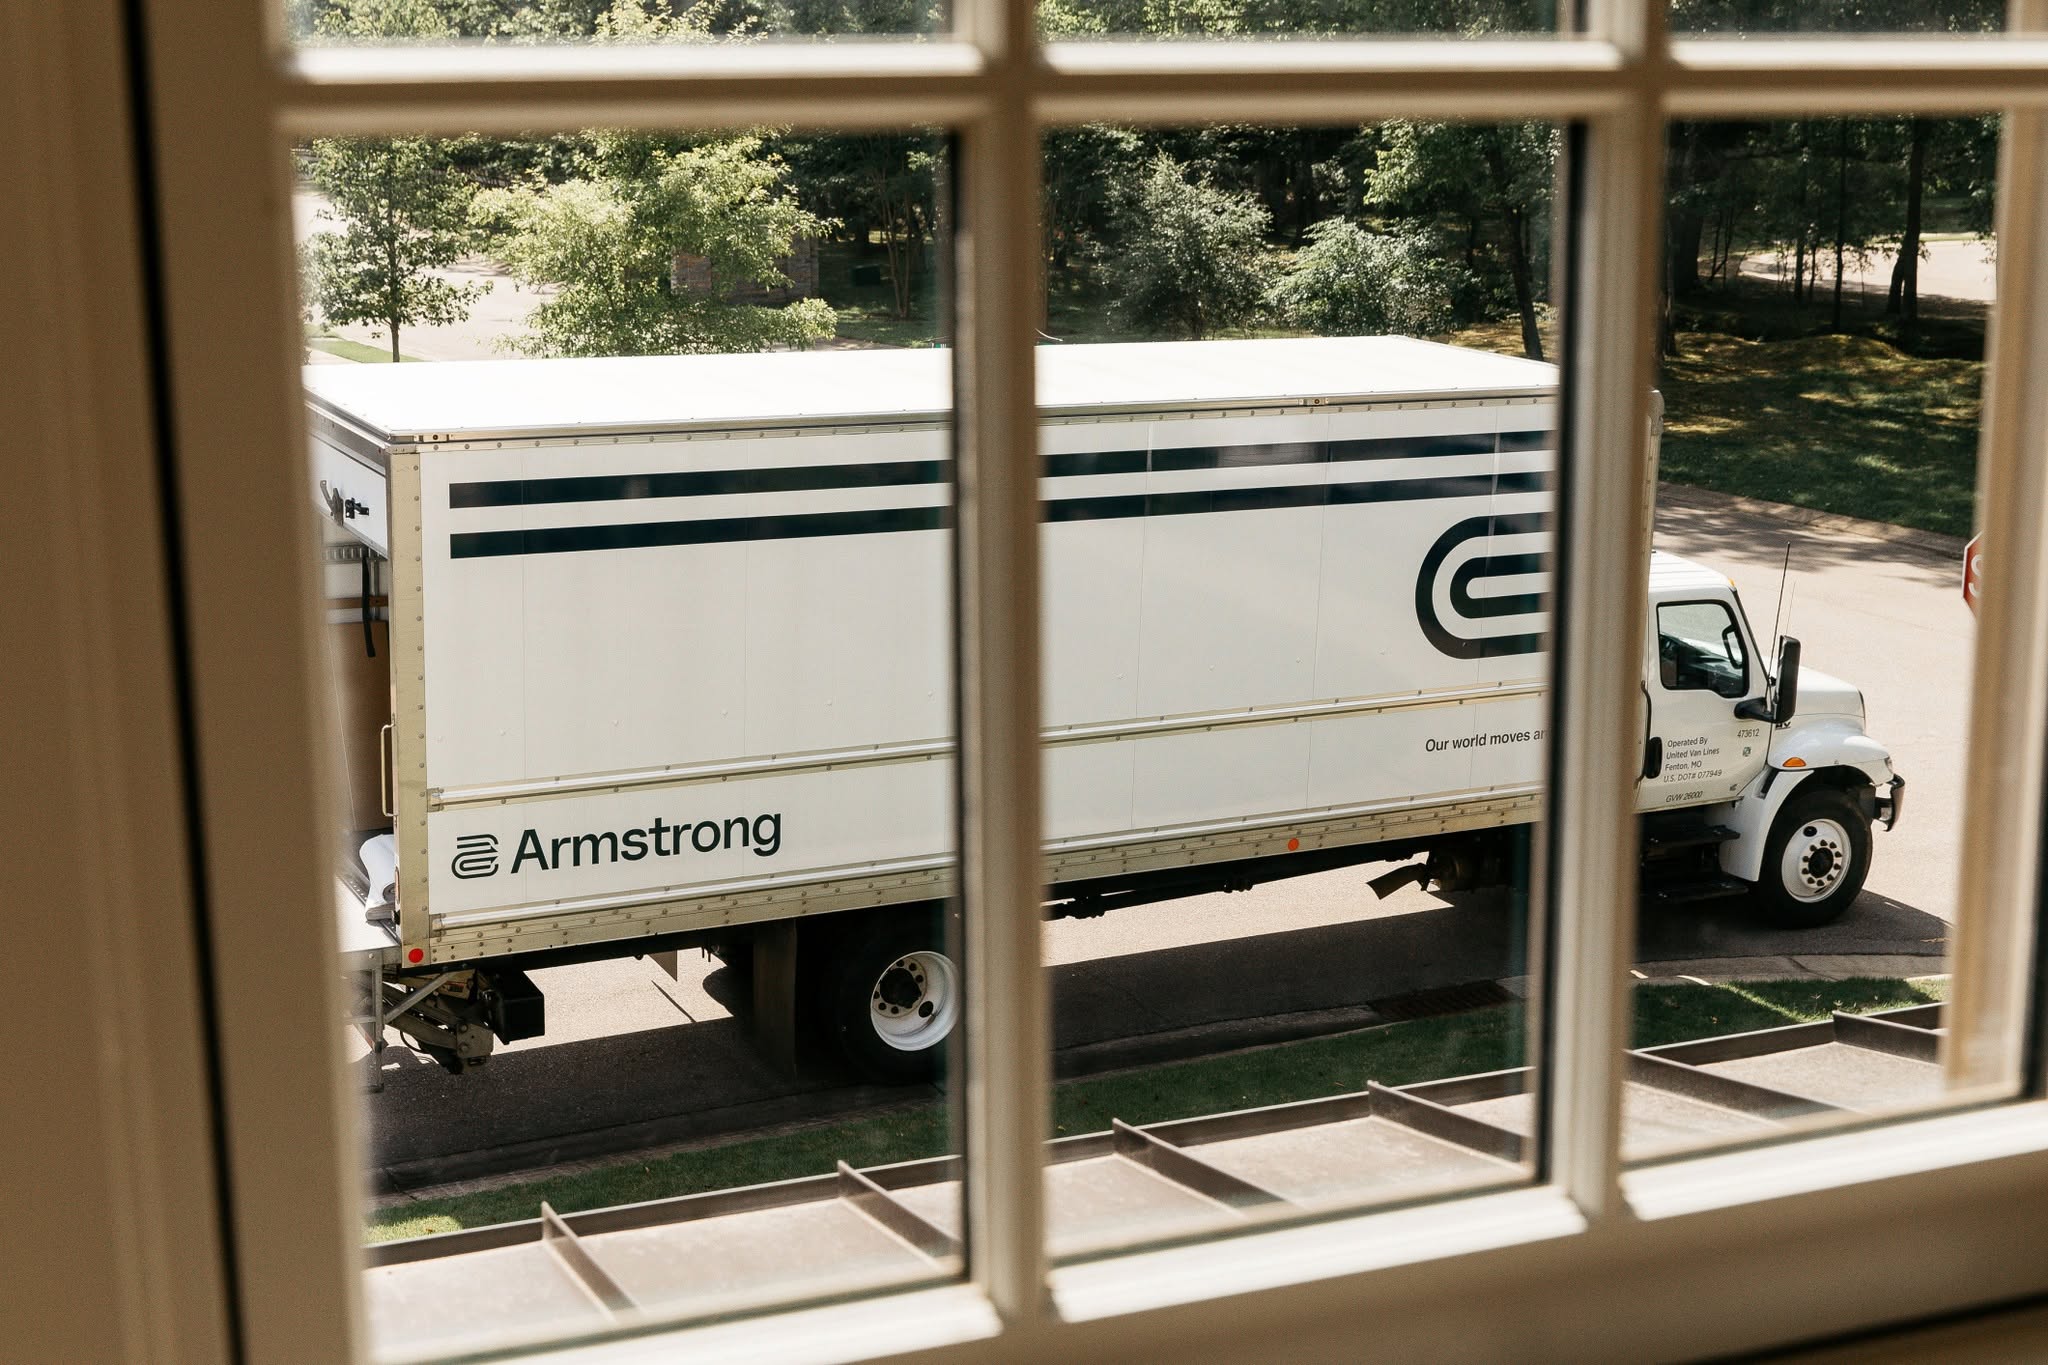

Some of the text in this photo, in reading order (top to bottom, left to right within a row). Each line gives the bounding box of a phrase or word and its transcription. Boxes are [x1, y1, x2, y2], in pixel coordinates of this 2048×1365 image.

[1737, 728, 1760, 738] 473612
[1425, 739, 1449, 752] Our
[1452, 733, 1487, 749] world
[1490, 731, 1530, 745] moves
[1667, 736, 1708, 748] Operated By
[1666, 751, 1688, 760] United
[1702, 747, 1720, 756] Lines
[1664, 760, 1702, 771] Fenton, MO
[1663, 769, 1723, 783] U.S. DOT# 077949
[1665, 790, 1703, 803] GVW 26000
[511, 813, 781, 874] Armstrong
